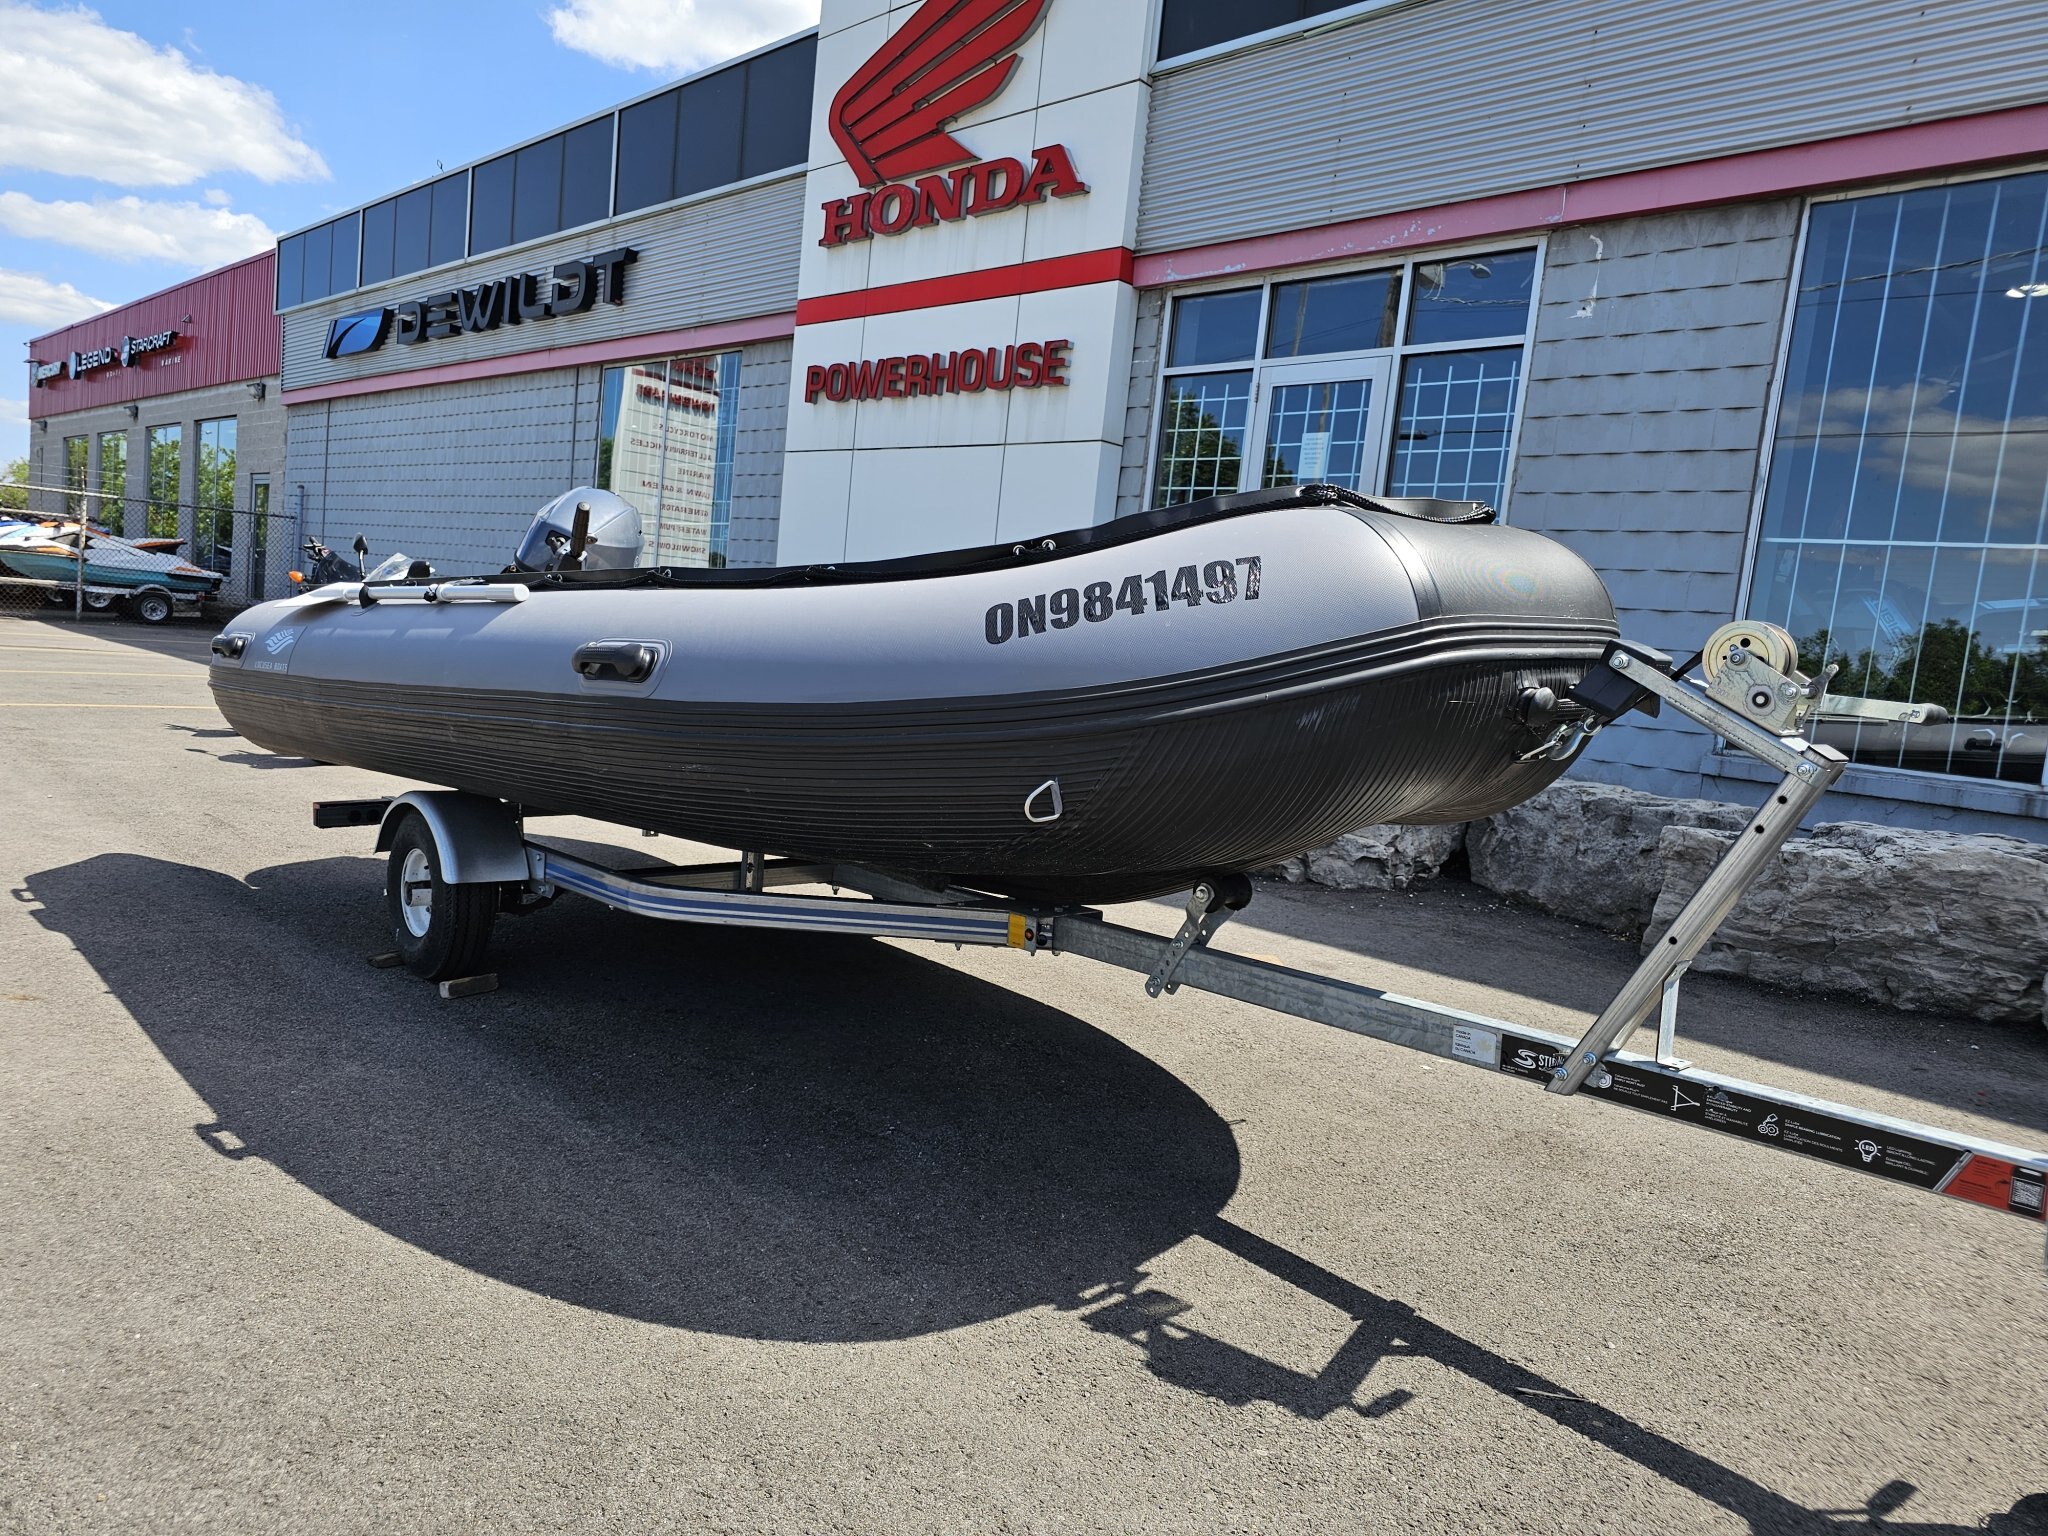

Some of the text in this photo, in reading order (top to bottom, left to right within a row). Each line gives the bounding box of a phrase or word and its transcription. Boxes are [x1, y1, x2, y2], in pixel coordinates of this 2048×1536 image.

[819, 143, 1090, 249] HONDA
[396, 247, 639, 345] DEWILDT
[76, 346, 114, 372] LEGEND
[130, 330, 176, 355] STARCRAFT
[805, 339, 1074, 404] POWERHOUSE
[985, 555, 1262, 645] ON9841497
[1861, 1144, 1874, 1152] LED
